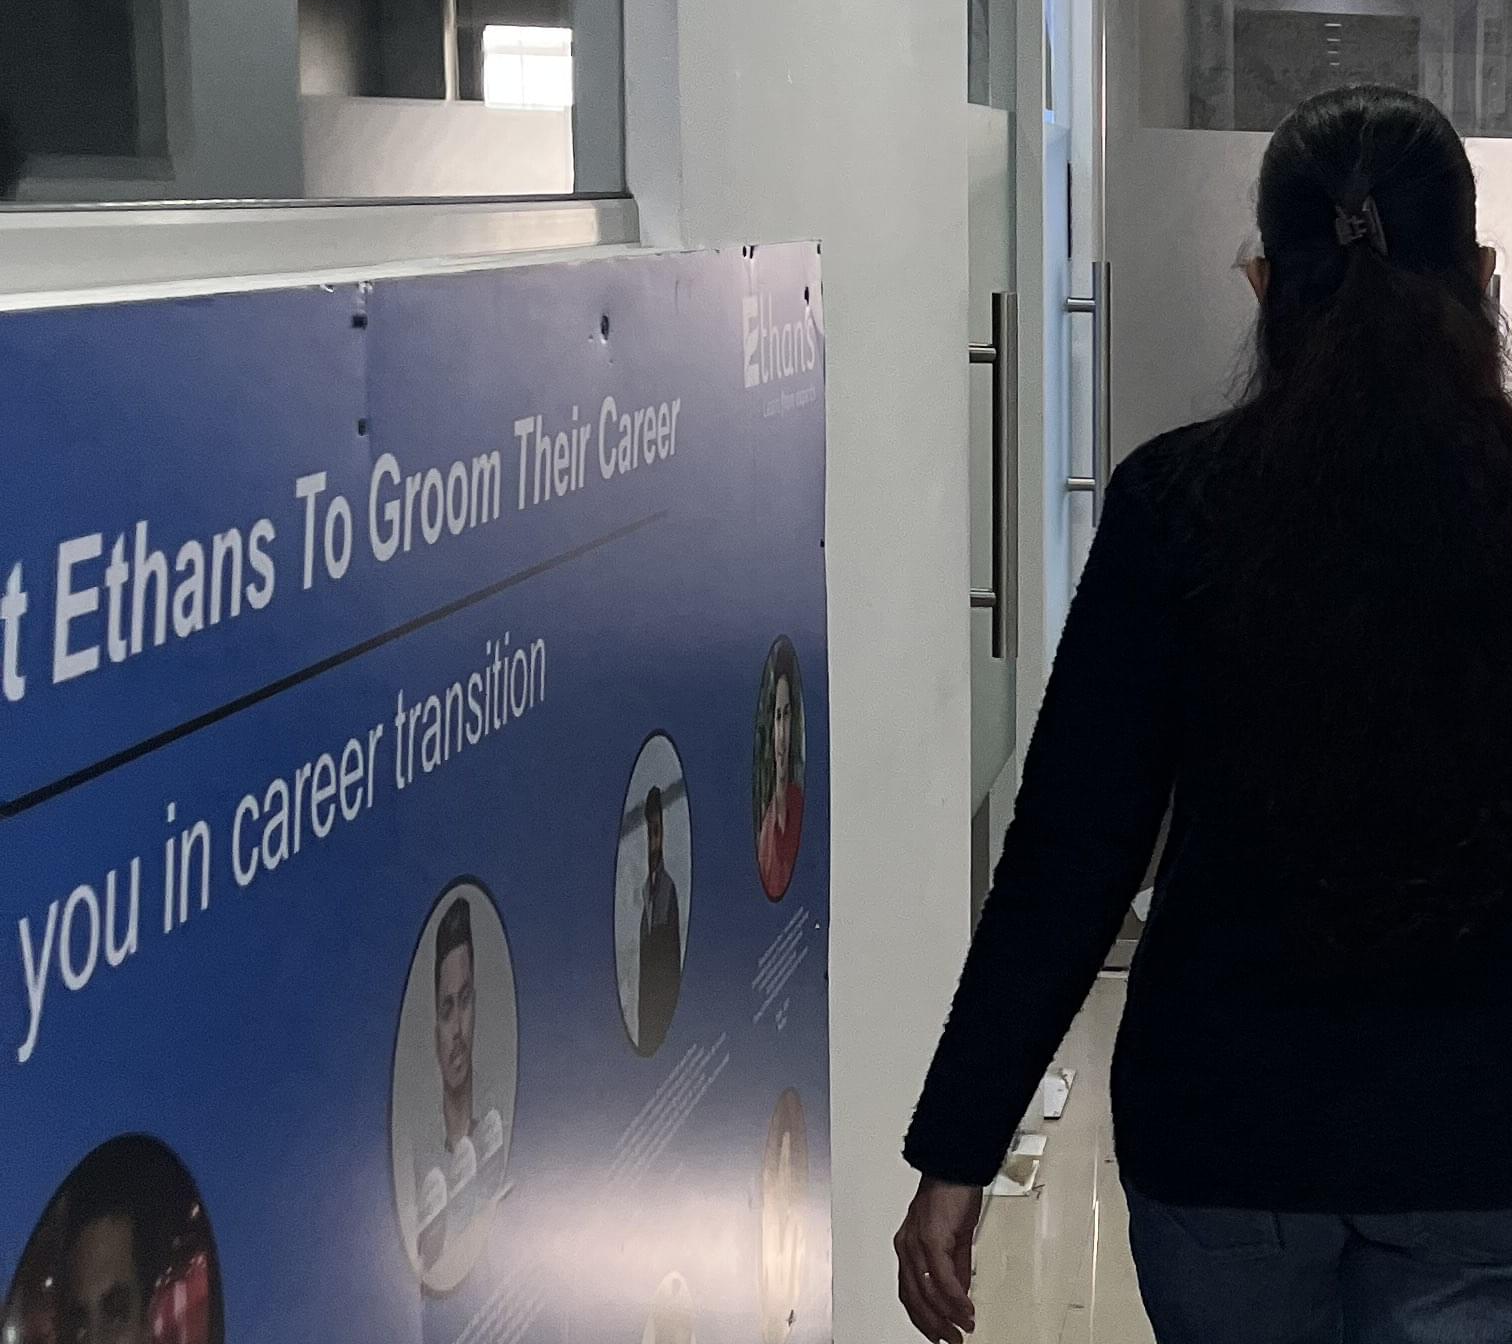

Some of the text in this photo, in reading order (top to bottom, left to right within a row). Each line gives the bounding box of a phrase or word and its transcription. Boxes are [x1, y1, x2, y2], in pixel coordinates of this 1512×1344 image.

[741, 290, 816, 389] Ethans
[52, 517, 276, 685] Ethans
[295, 471, 353, 590] To
[369, 450, 501, 562] Groom
[513, 405, 592, 510] Their
[598, 395, 681, 480] Career
[17, 630, 546, 1063] you in career transition
